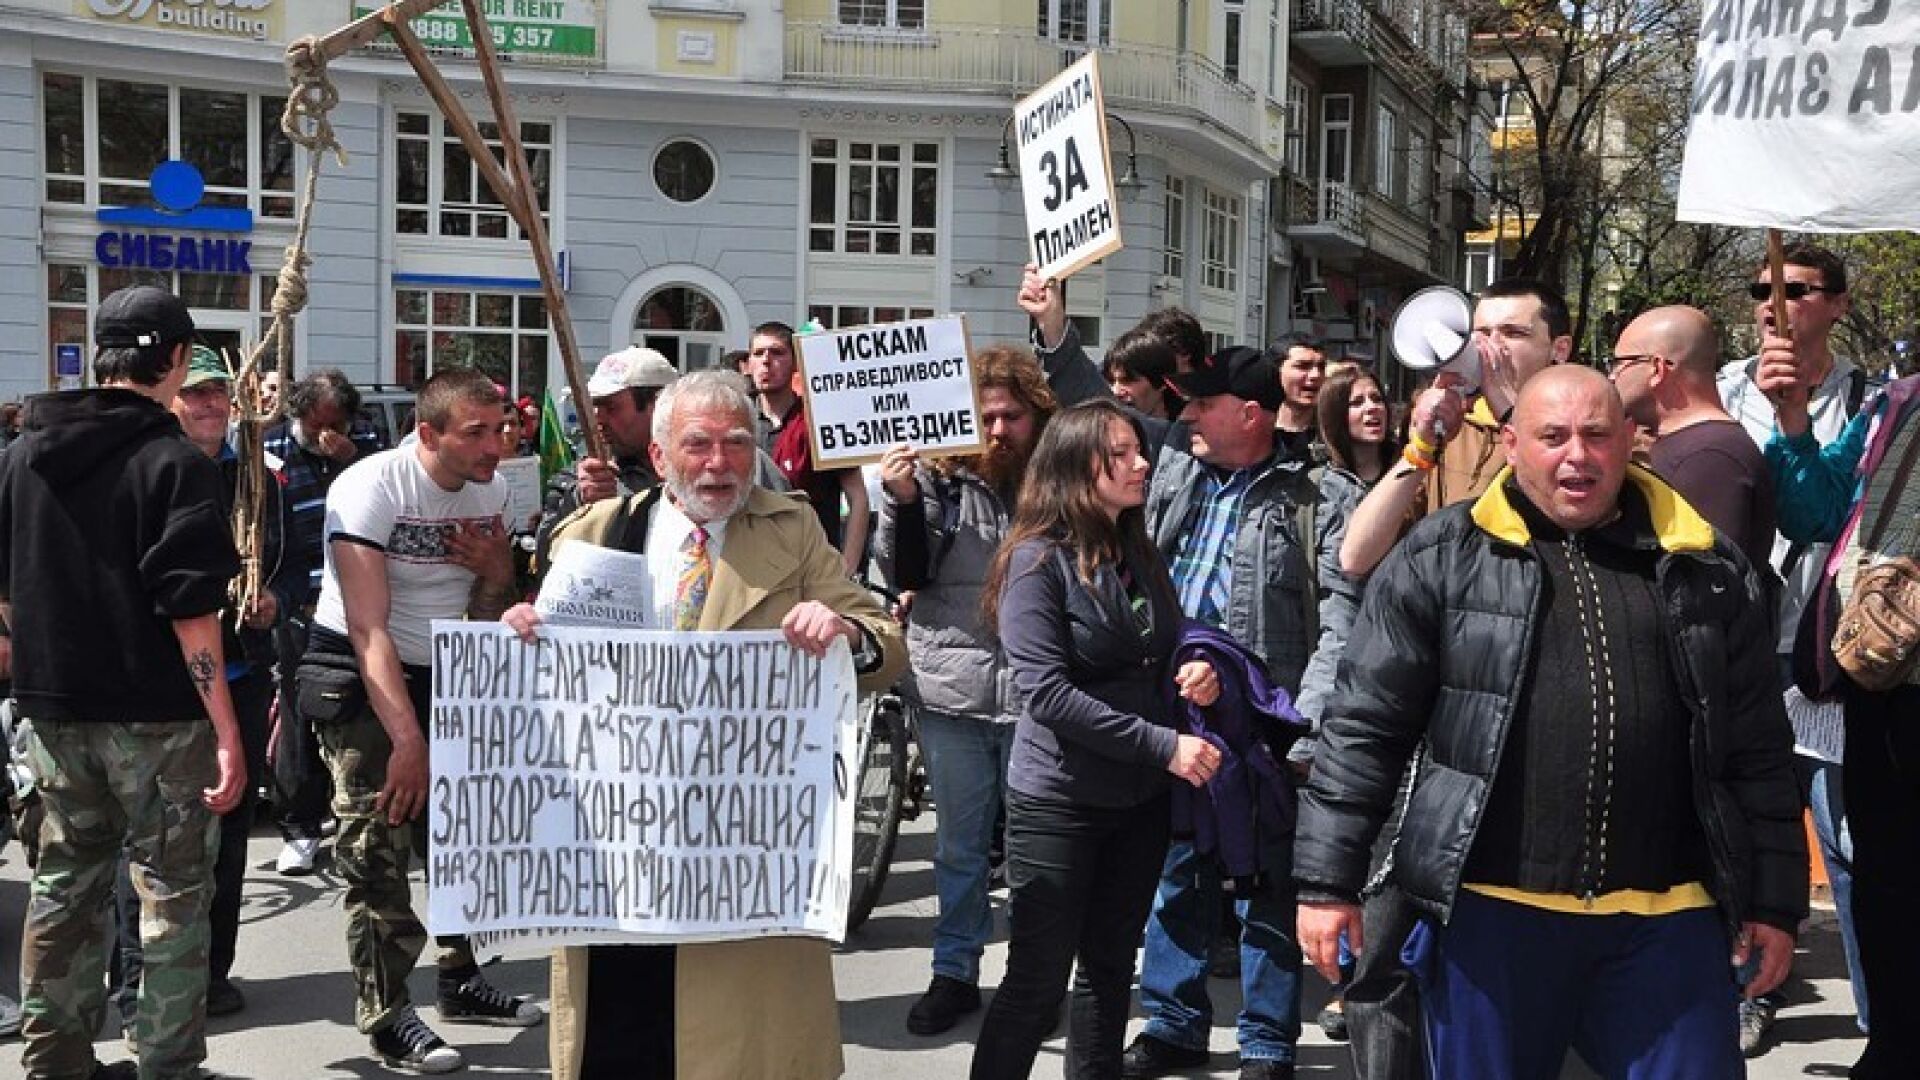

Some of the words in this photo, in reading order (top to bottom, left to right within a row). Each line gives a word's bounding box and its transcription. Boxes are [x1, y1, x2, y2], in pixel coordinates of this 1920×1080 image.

[157, 2, 268, 41] building
[513, 1, 565, 19] RENT
[512, 28, 554, 47] 357
[1019, 72, 1093, 147] ИСТИНАТА
[1039, 136, 1089, 212] ЗА
[96, 230, 252, 274] СИБАНК
[1034, 199, 1113, 269] ПЛАМЕН
[837, 326, 927, 362] ИСКАМ
[810, 357, 964, 393] СПРАВЕДЛИВОСТ
[872, 391, 911, 413] ИЛИ
[820, 409, 973, 449] ВЪЗМЕЗДИЕ
[434, 631, 588, 702] ГРАБИТЕЛИ
[606, 640, 822, 714] УНИЩОЖИТЕЛИ
[435, 704, 464, 740] НА
[432, 773, 544, 847] ЗАТВОР
[574, 777, 817, 852] КОНФИСКАЦИЯ
[434, 850, 465, 889] НА
[462, 845, 631, 924] ЗАГРАБЕНИ
